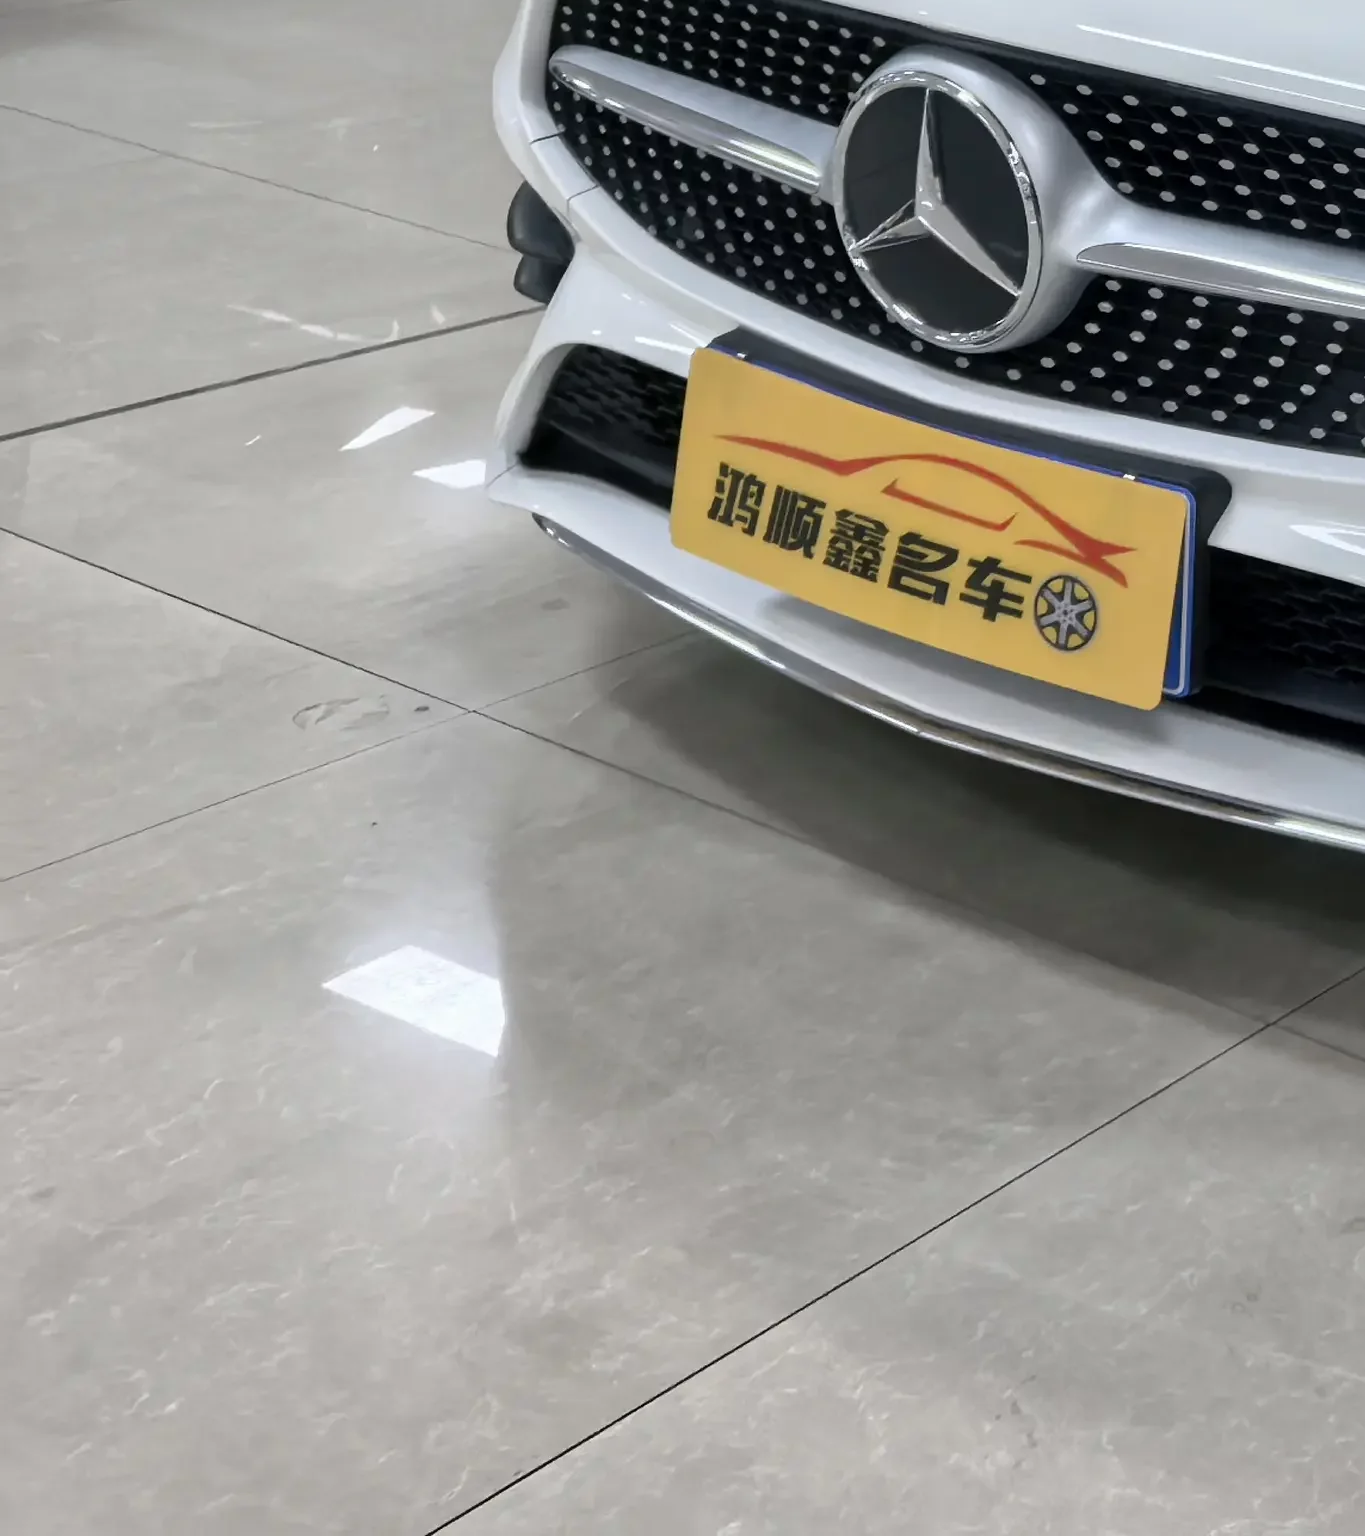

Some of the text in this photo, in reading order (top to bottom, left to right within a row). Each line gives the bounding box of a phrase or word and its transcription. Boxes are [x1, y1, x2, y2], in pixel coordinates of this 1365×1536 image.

[707, 461, 1033, 622] 鸿顺鑫名车
